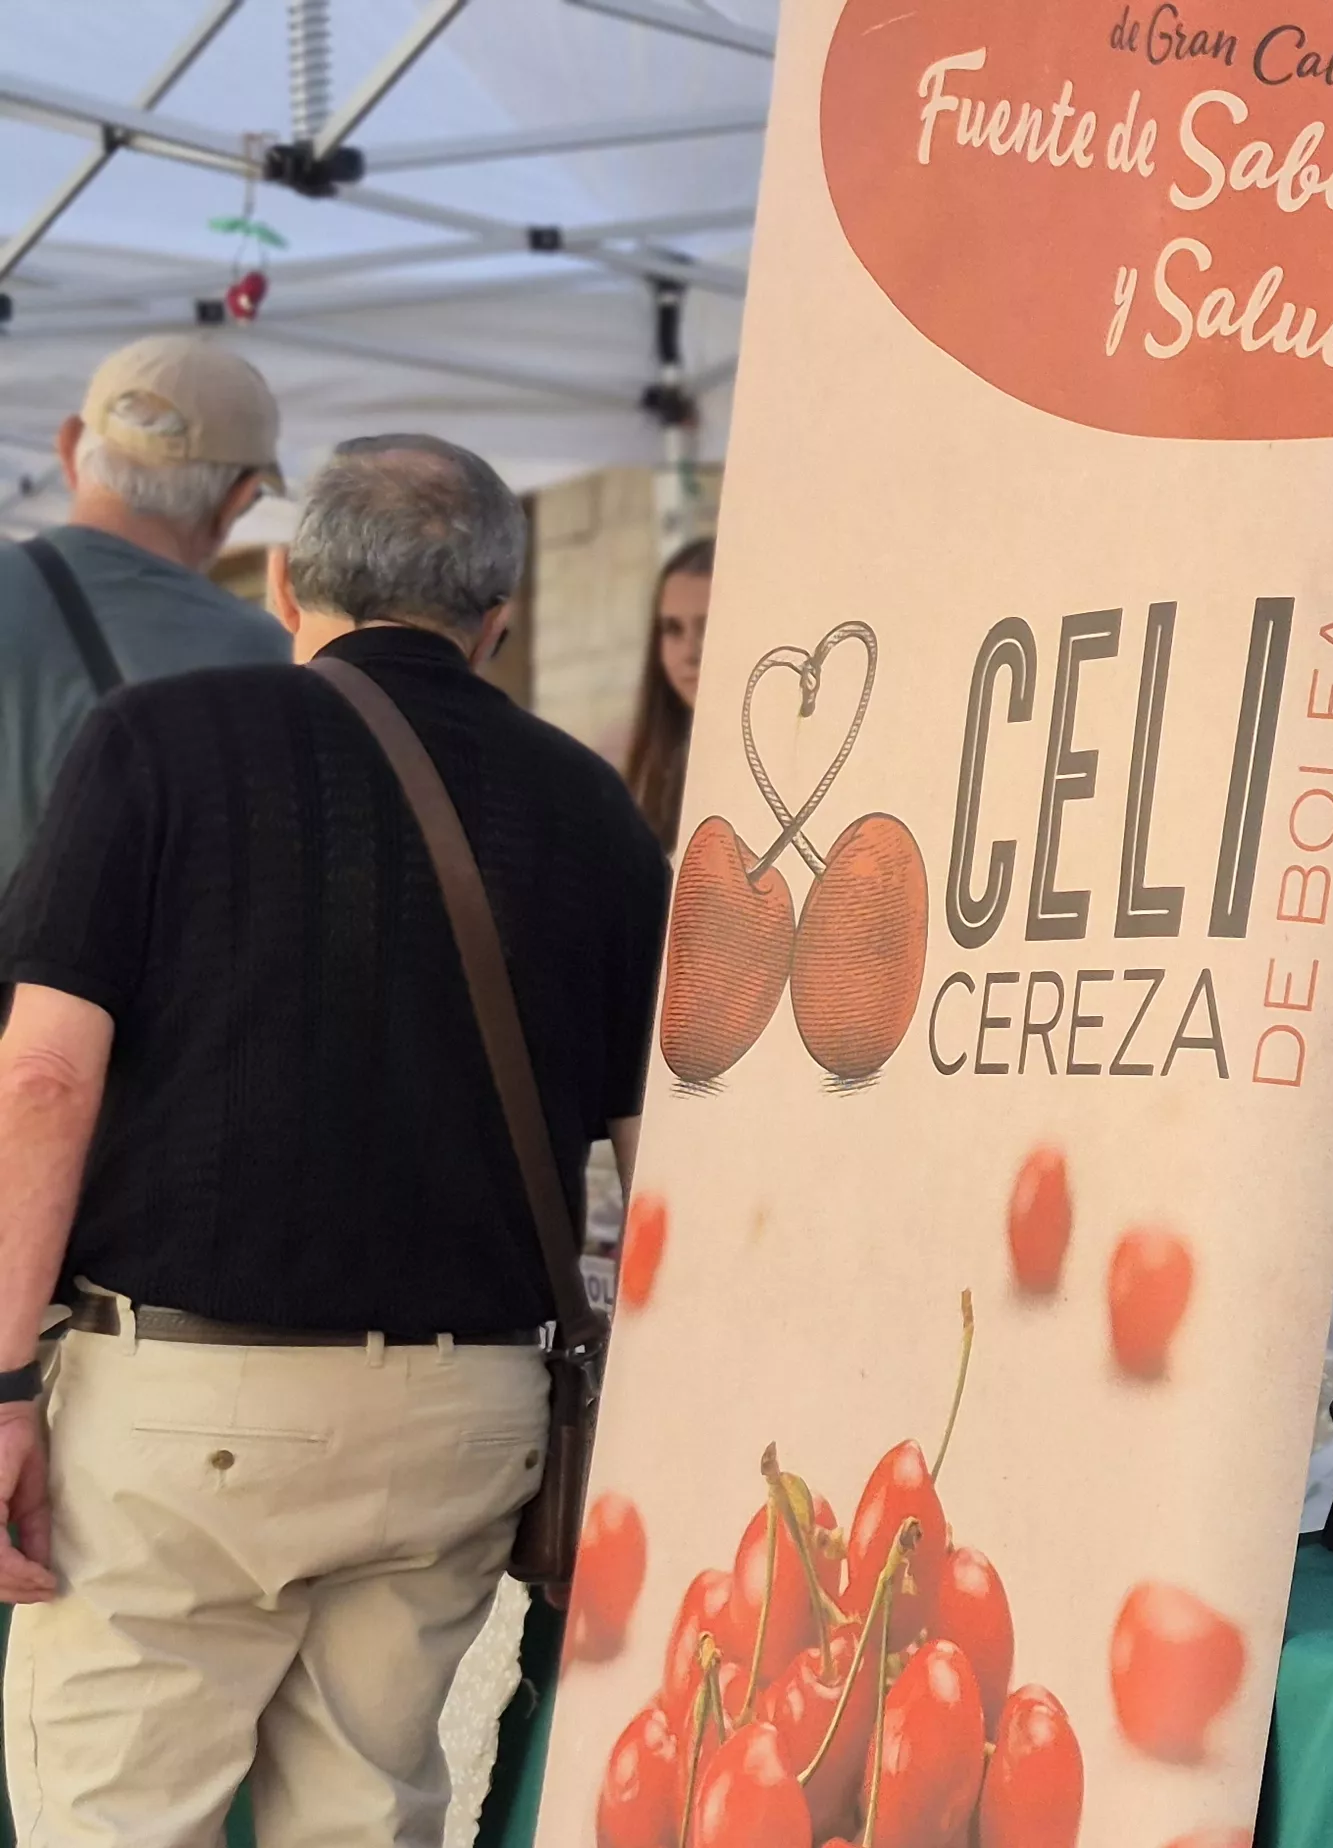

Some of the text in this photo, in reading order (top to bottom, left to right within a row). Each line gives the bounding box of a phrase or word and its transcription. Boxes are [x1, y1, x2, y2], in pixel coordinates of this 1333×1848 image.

[1110, 5, 1140, 52] de
[1146, 3, 1238, 66] Gran
[917, 47, 1095, 168] Fuente
[1107, 89, 1158, 177] de
[1106, 265, 1136, 357] y
[945, 596, 1296, 949] CELI
[928, 967, 1231, 1083] CEREZA
[1252, 957, 1323, 1087] DE
